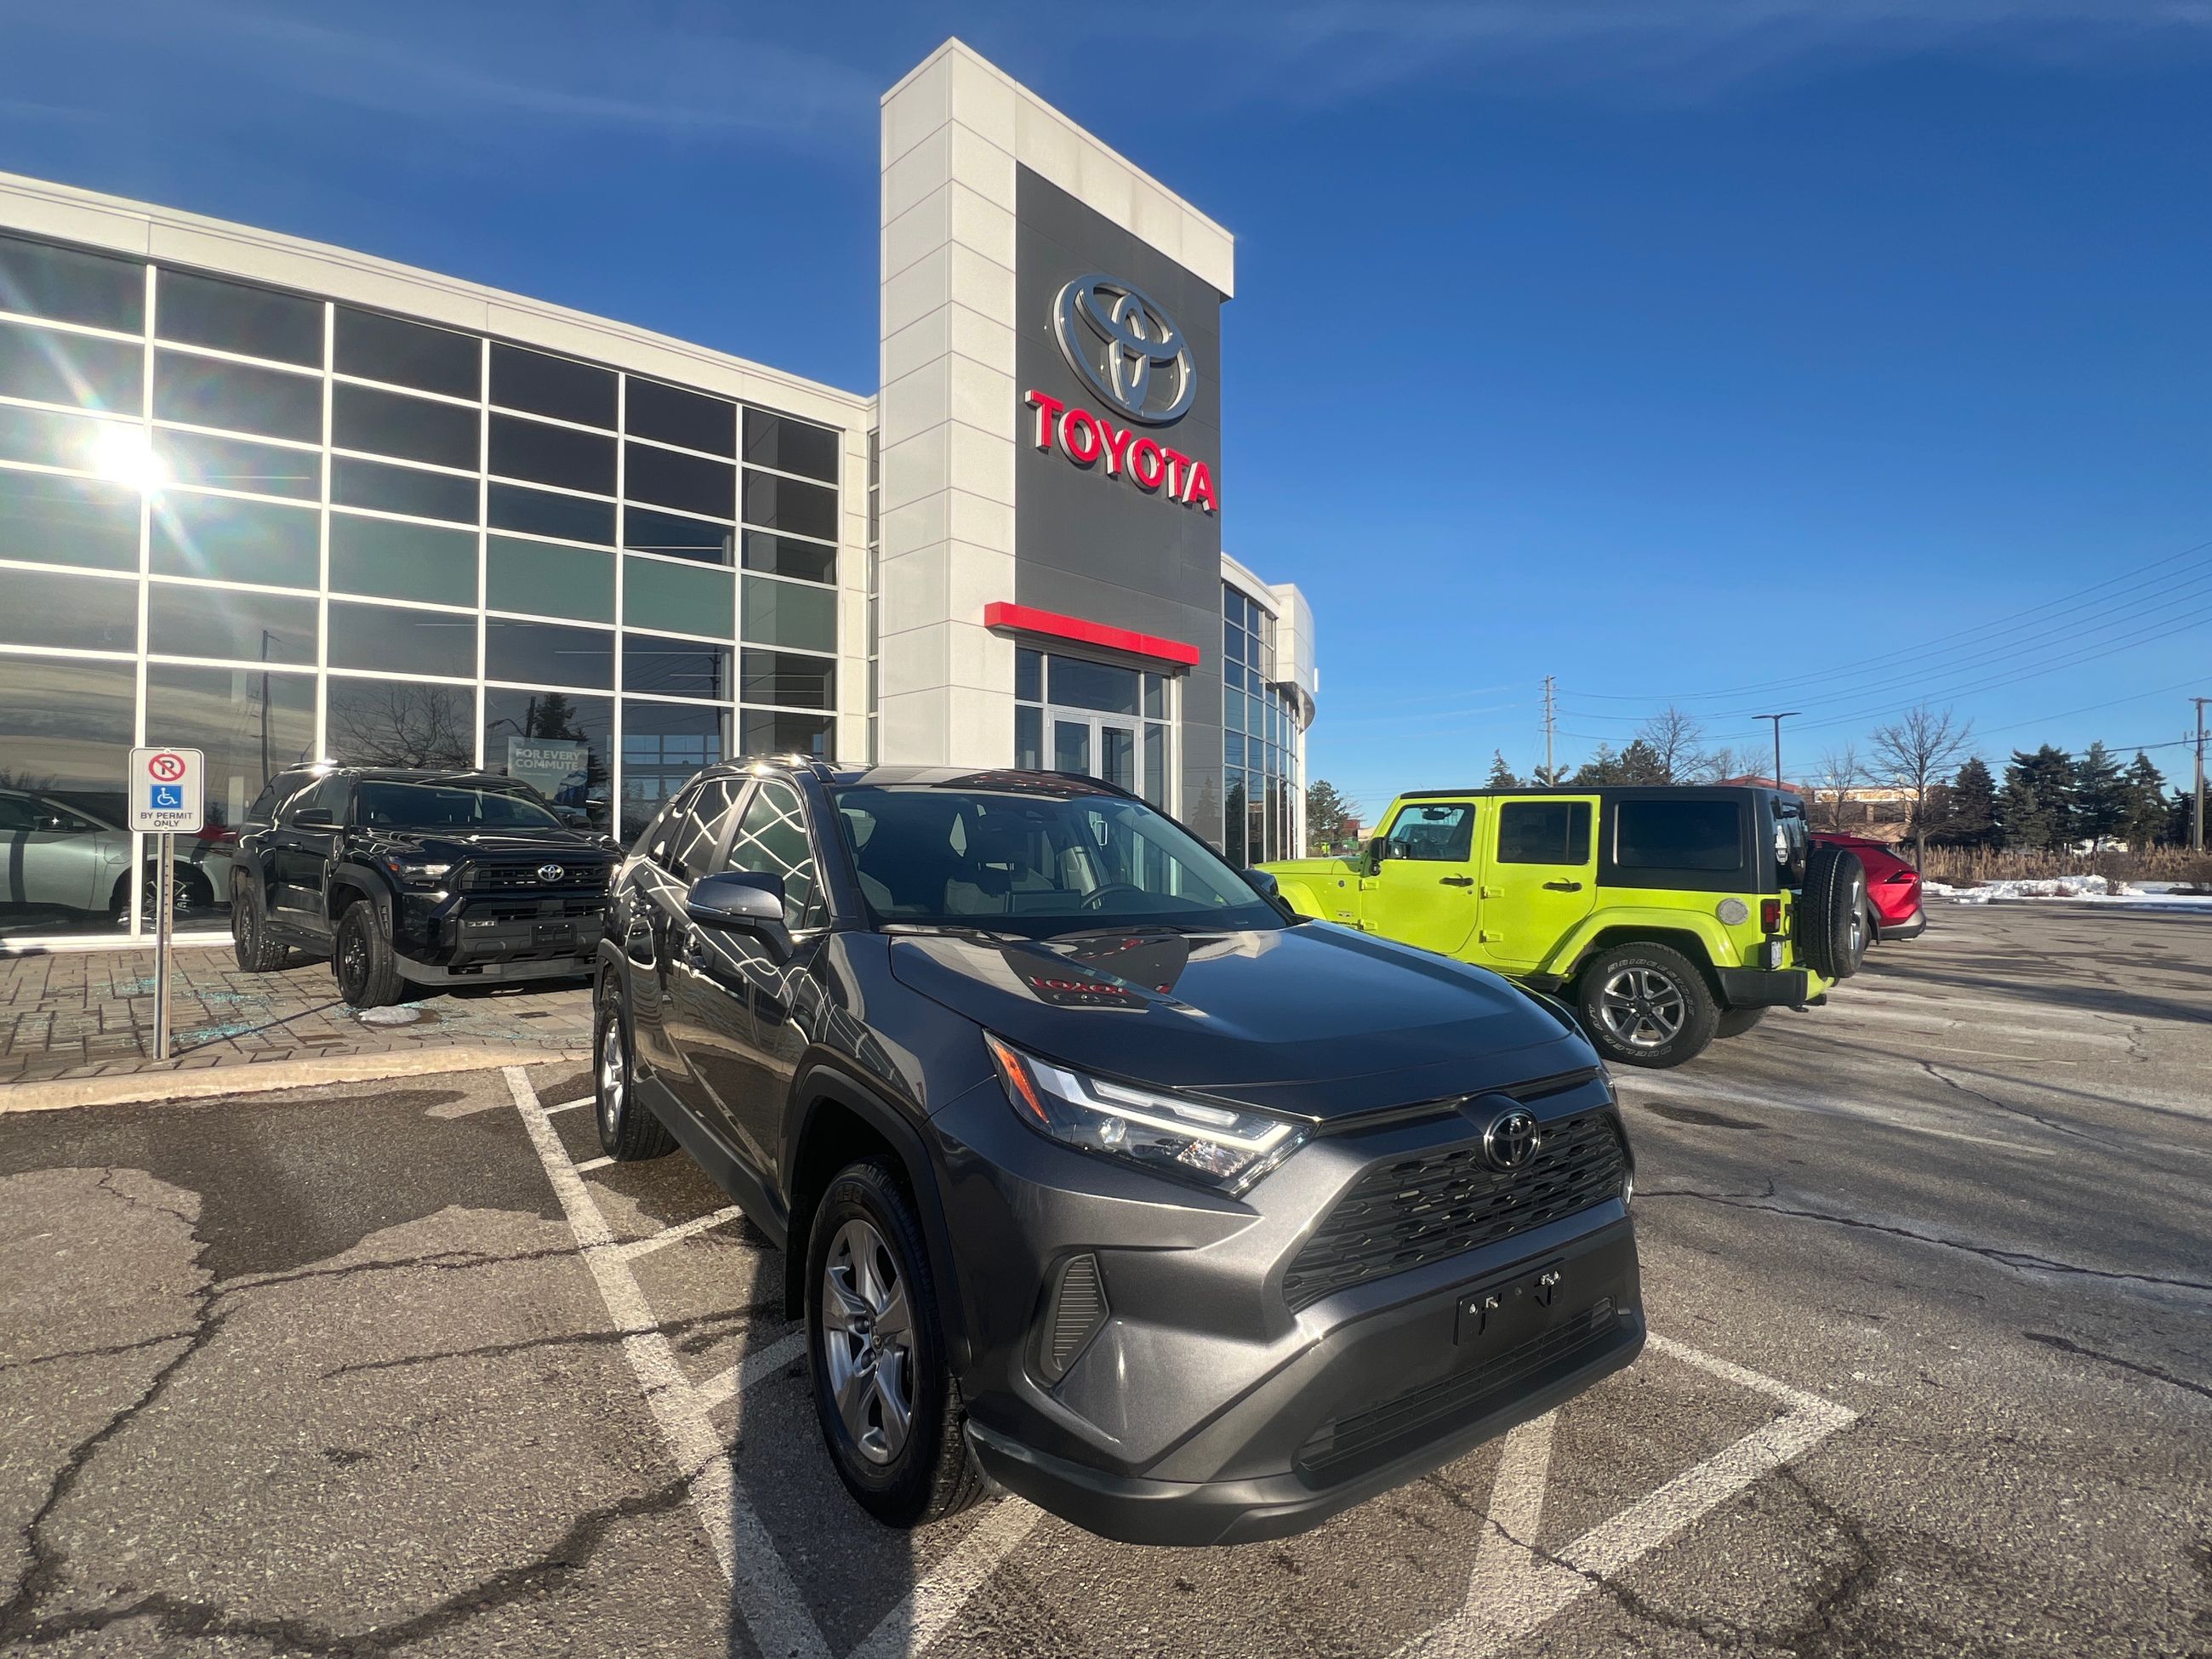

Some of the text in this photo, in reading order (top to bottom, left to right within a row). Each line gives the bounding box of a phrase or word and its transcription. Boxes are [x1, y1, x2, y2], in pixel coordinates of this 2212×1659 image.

[1024, 389, 1218, 511] TOYOTA
[516, 748, 580, 761] FOR EVERY
[515, 759, 579, 771] COMMUTE
